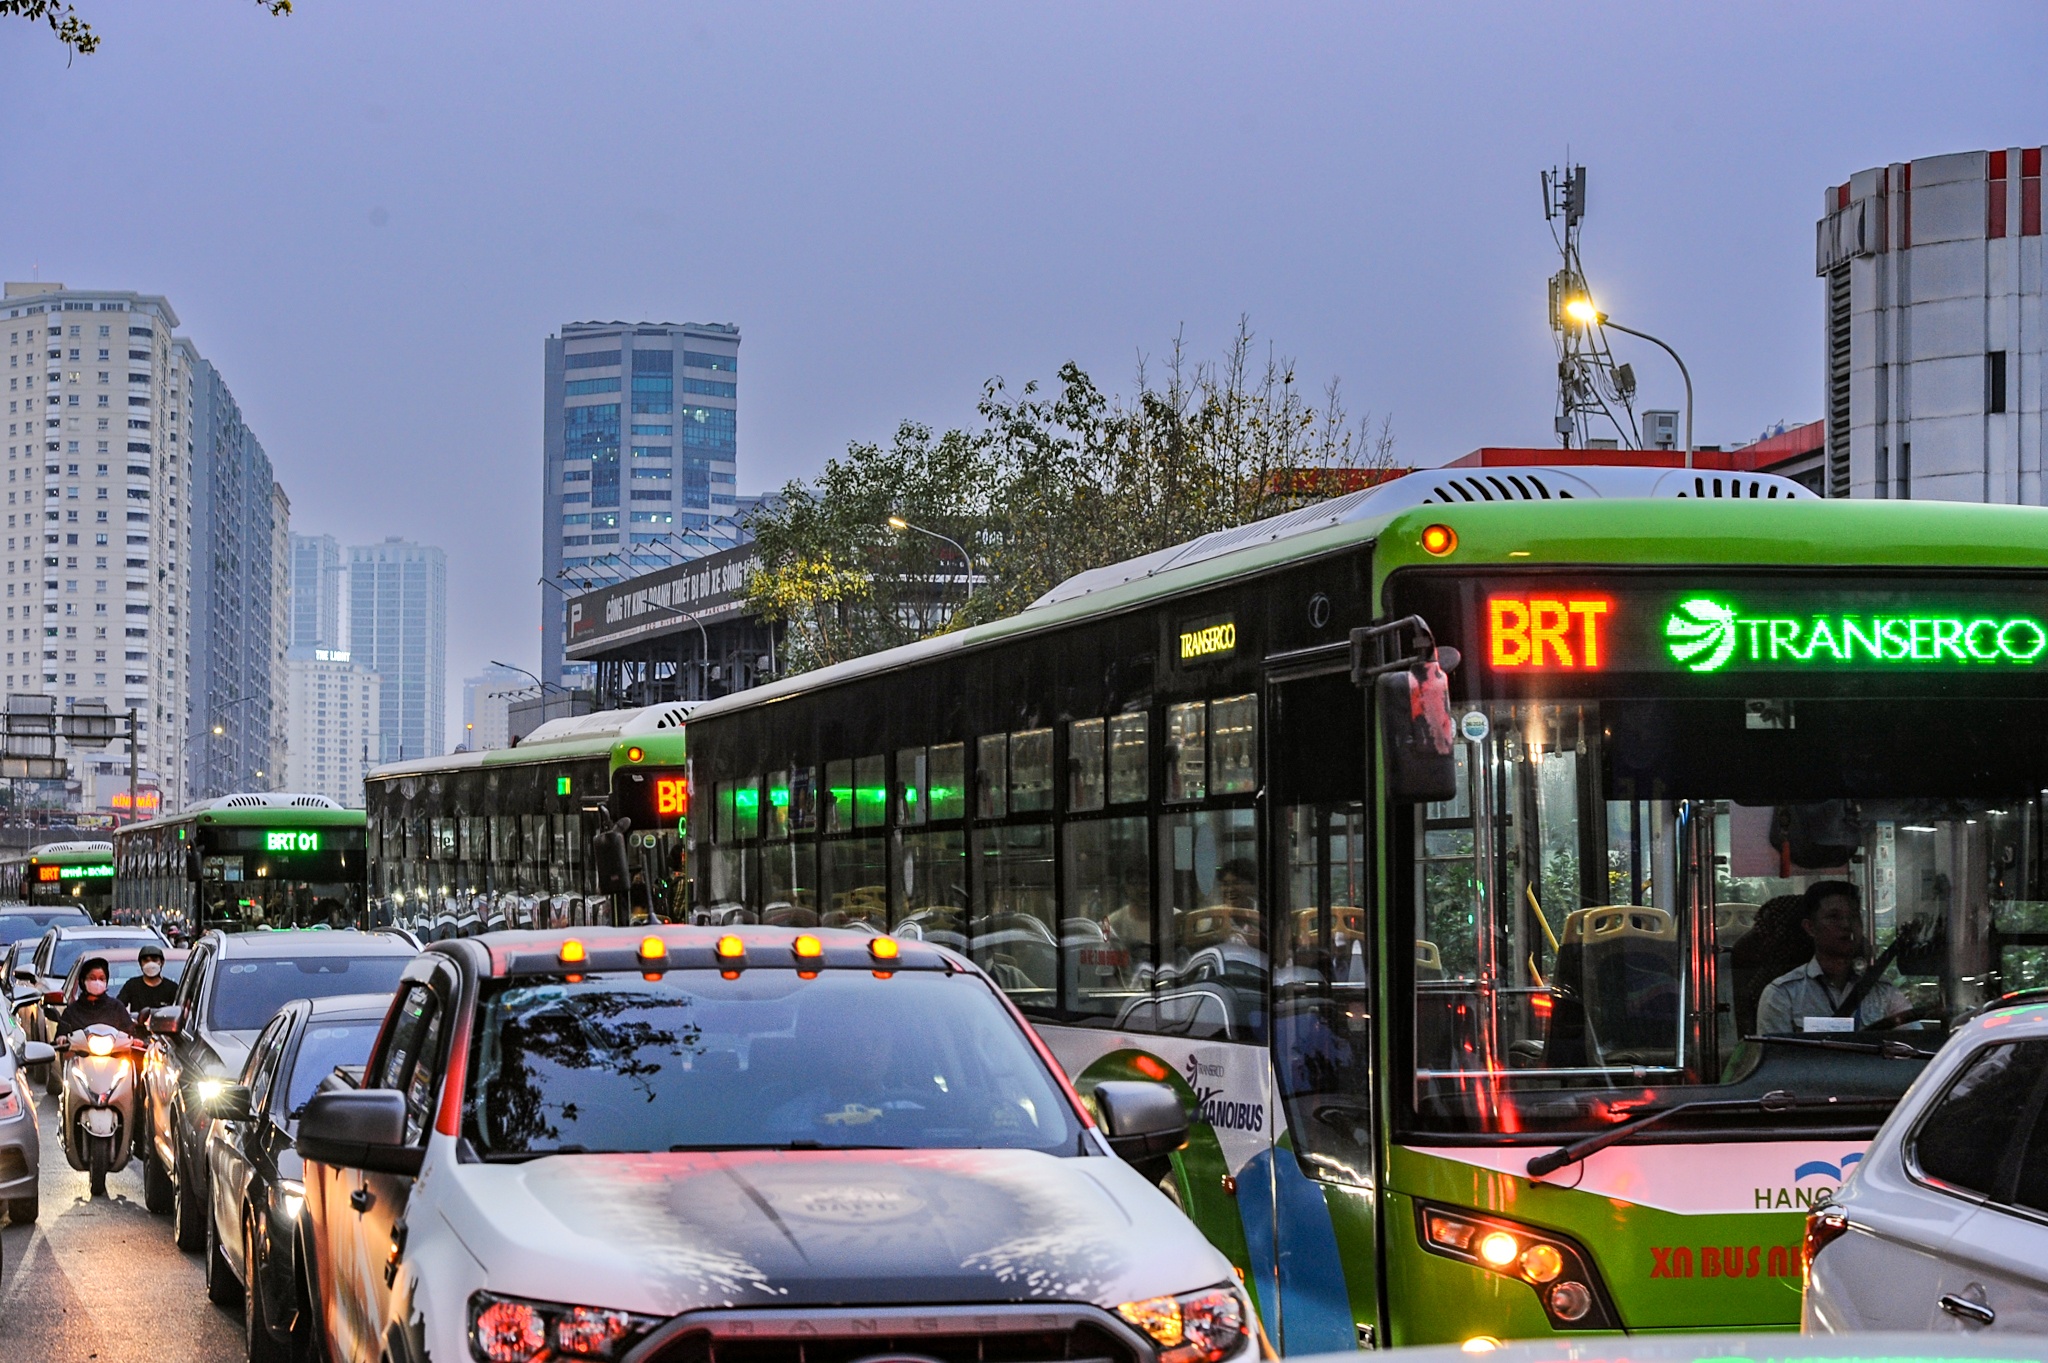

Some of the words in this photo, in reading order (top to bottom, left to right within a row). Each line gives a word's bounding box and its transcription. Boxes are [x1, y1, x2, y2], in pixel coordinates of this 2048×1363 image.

[624, 594, 632, 618] TY
[711, 568, 721, 595] XE
[722, 559, 743, 592] SÔNG
[1180, 623, 1236, 658] TRANSERCO
[1490, 597, 1609, 667] BRT
[1736, 618, 2046, 661] TRANSERCO
[316, 649, 329, 661] THE
[330, 650, 350, 662] LIGHT
[268, 832, 297, 850] BRT
[298, 832, 318, 850] 01
[40, 867, 60, 881] BRT
[1701, 1245, 1762, 1279] BUS
[729, 1314, 1059, 1336] RANGER
